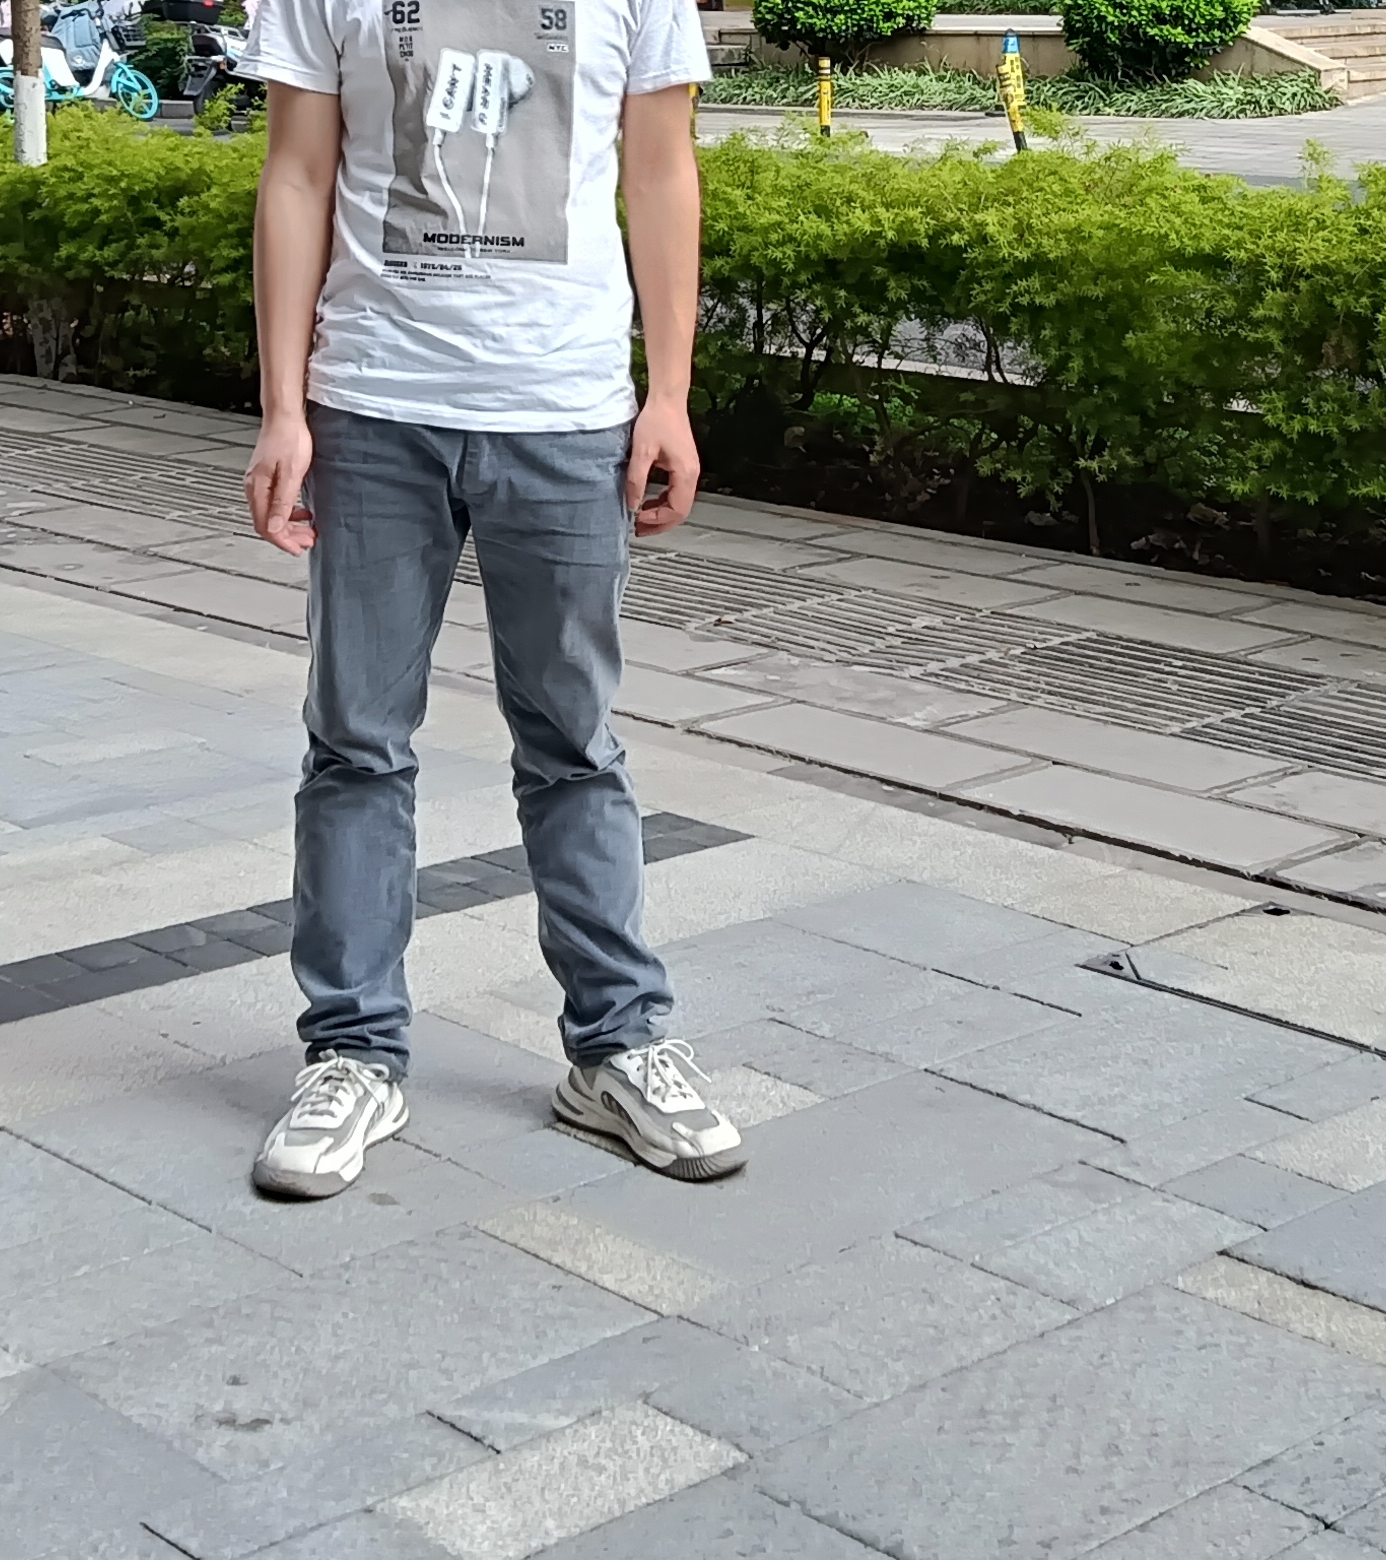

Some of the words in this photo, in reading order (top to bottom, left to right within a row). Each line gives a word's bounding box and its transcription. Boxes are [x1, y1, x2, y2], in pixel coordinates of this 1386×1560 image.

[391, 0, 421, 25] 62
[540, 7, 568, 31] 58
[423, 232, 525, 247] MODERNISM
